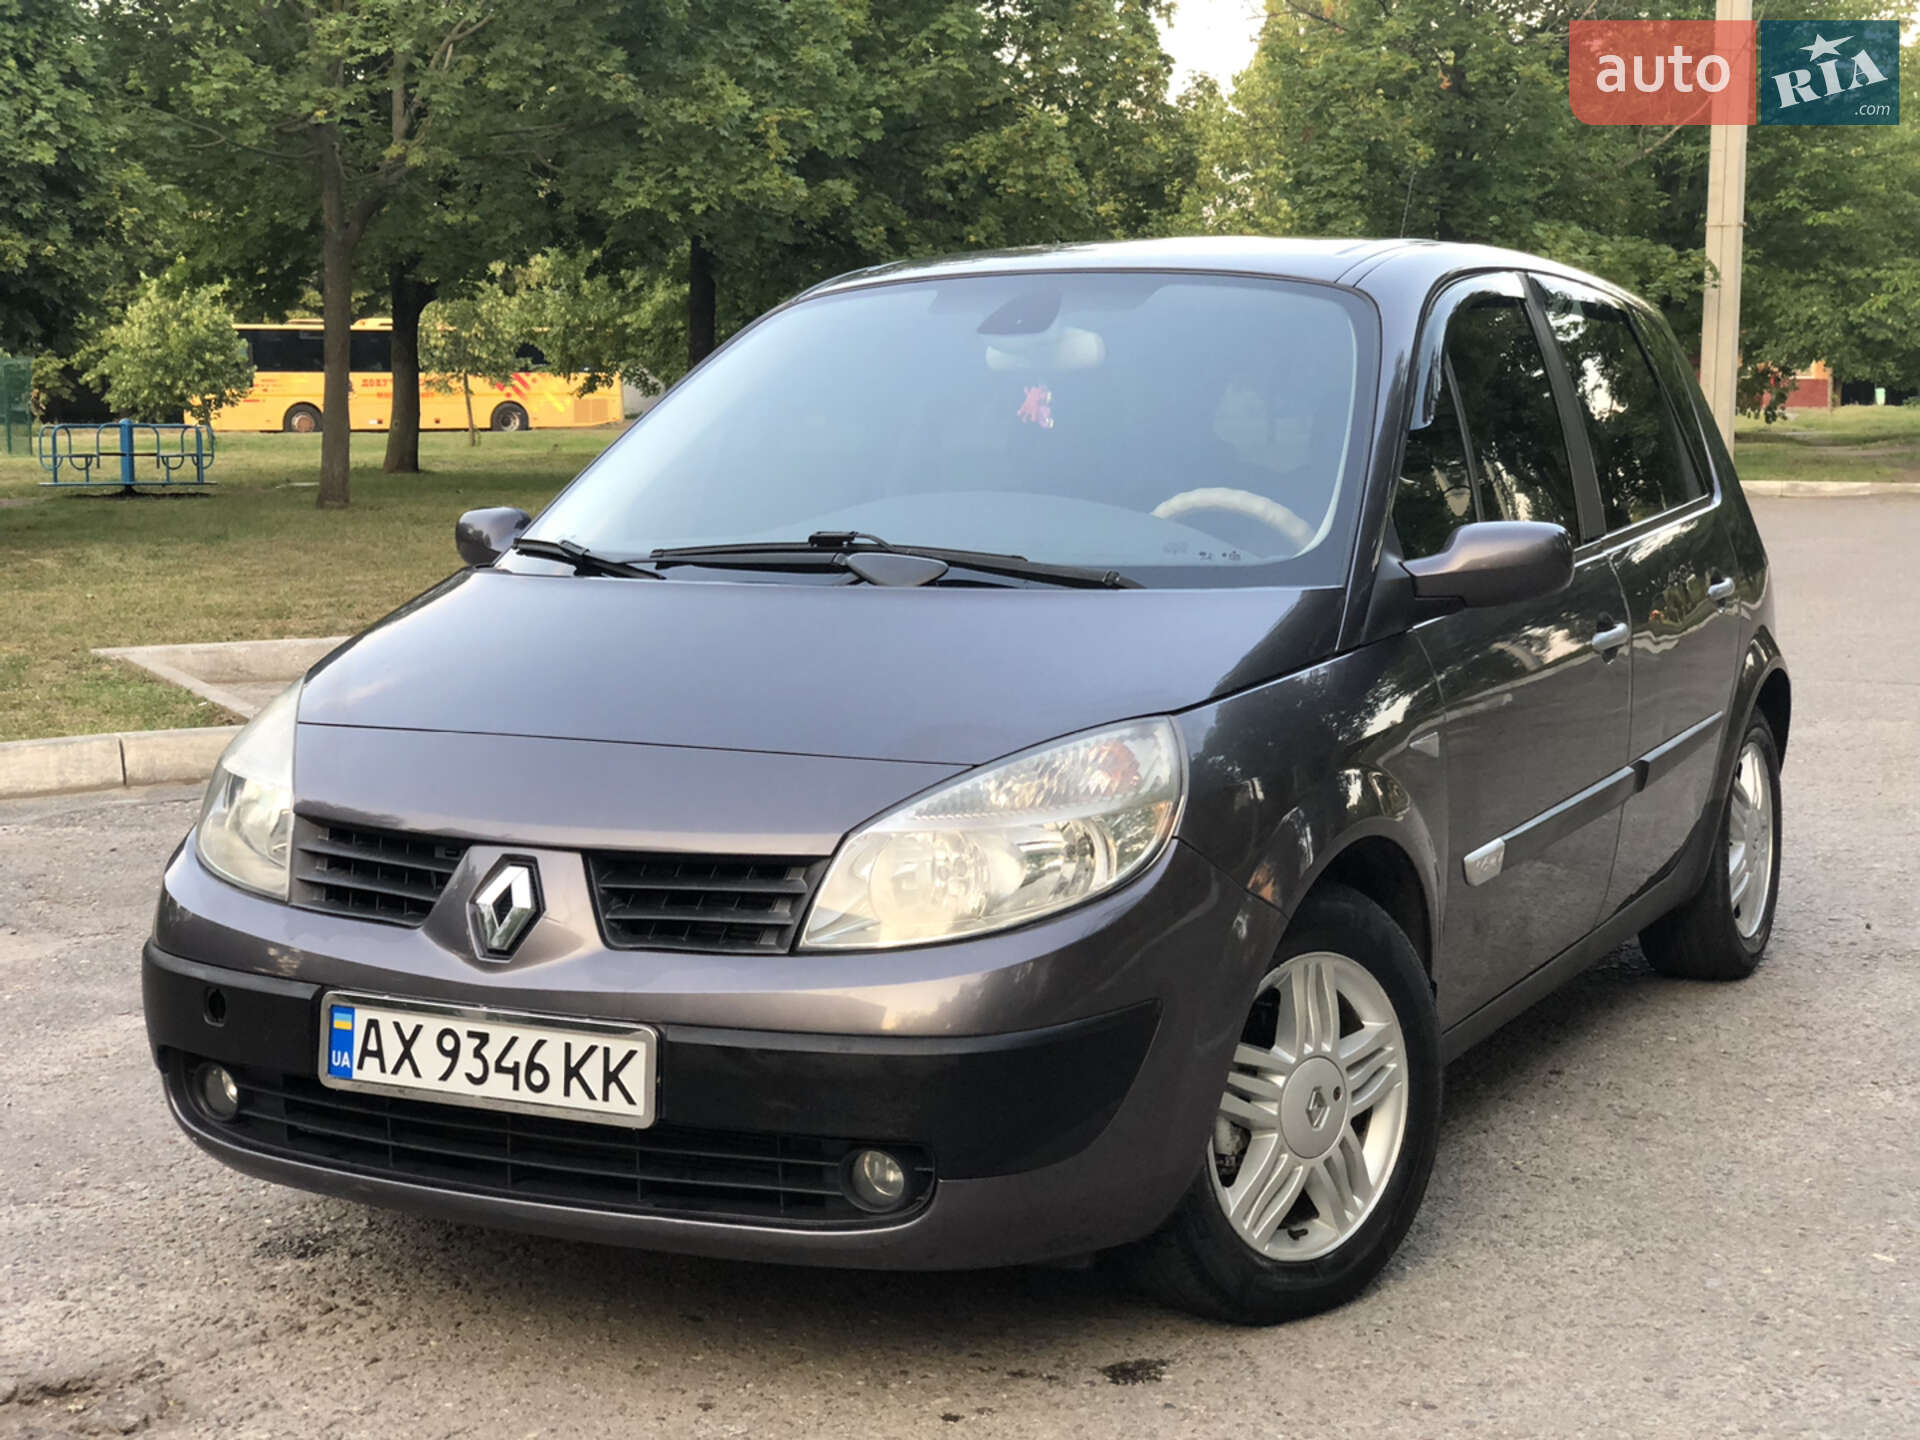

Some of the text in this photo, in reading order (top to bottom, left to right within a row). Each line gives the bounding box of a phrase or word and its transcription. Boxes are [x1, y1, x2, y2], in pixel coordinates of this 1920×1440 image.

[331, 1050, 351, 1068] UA
[356, 1018, 639, 1106] AX 9346 KK
